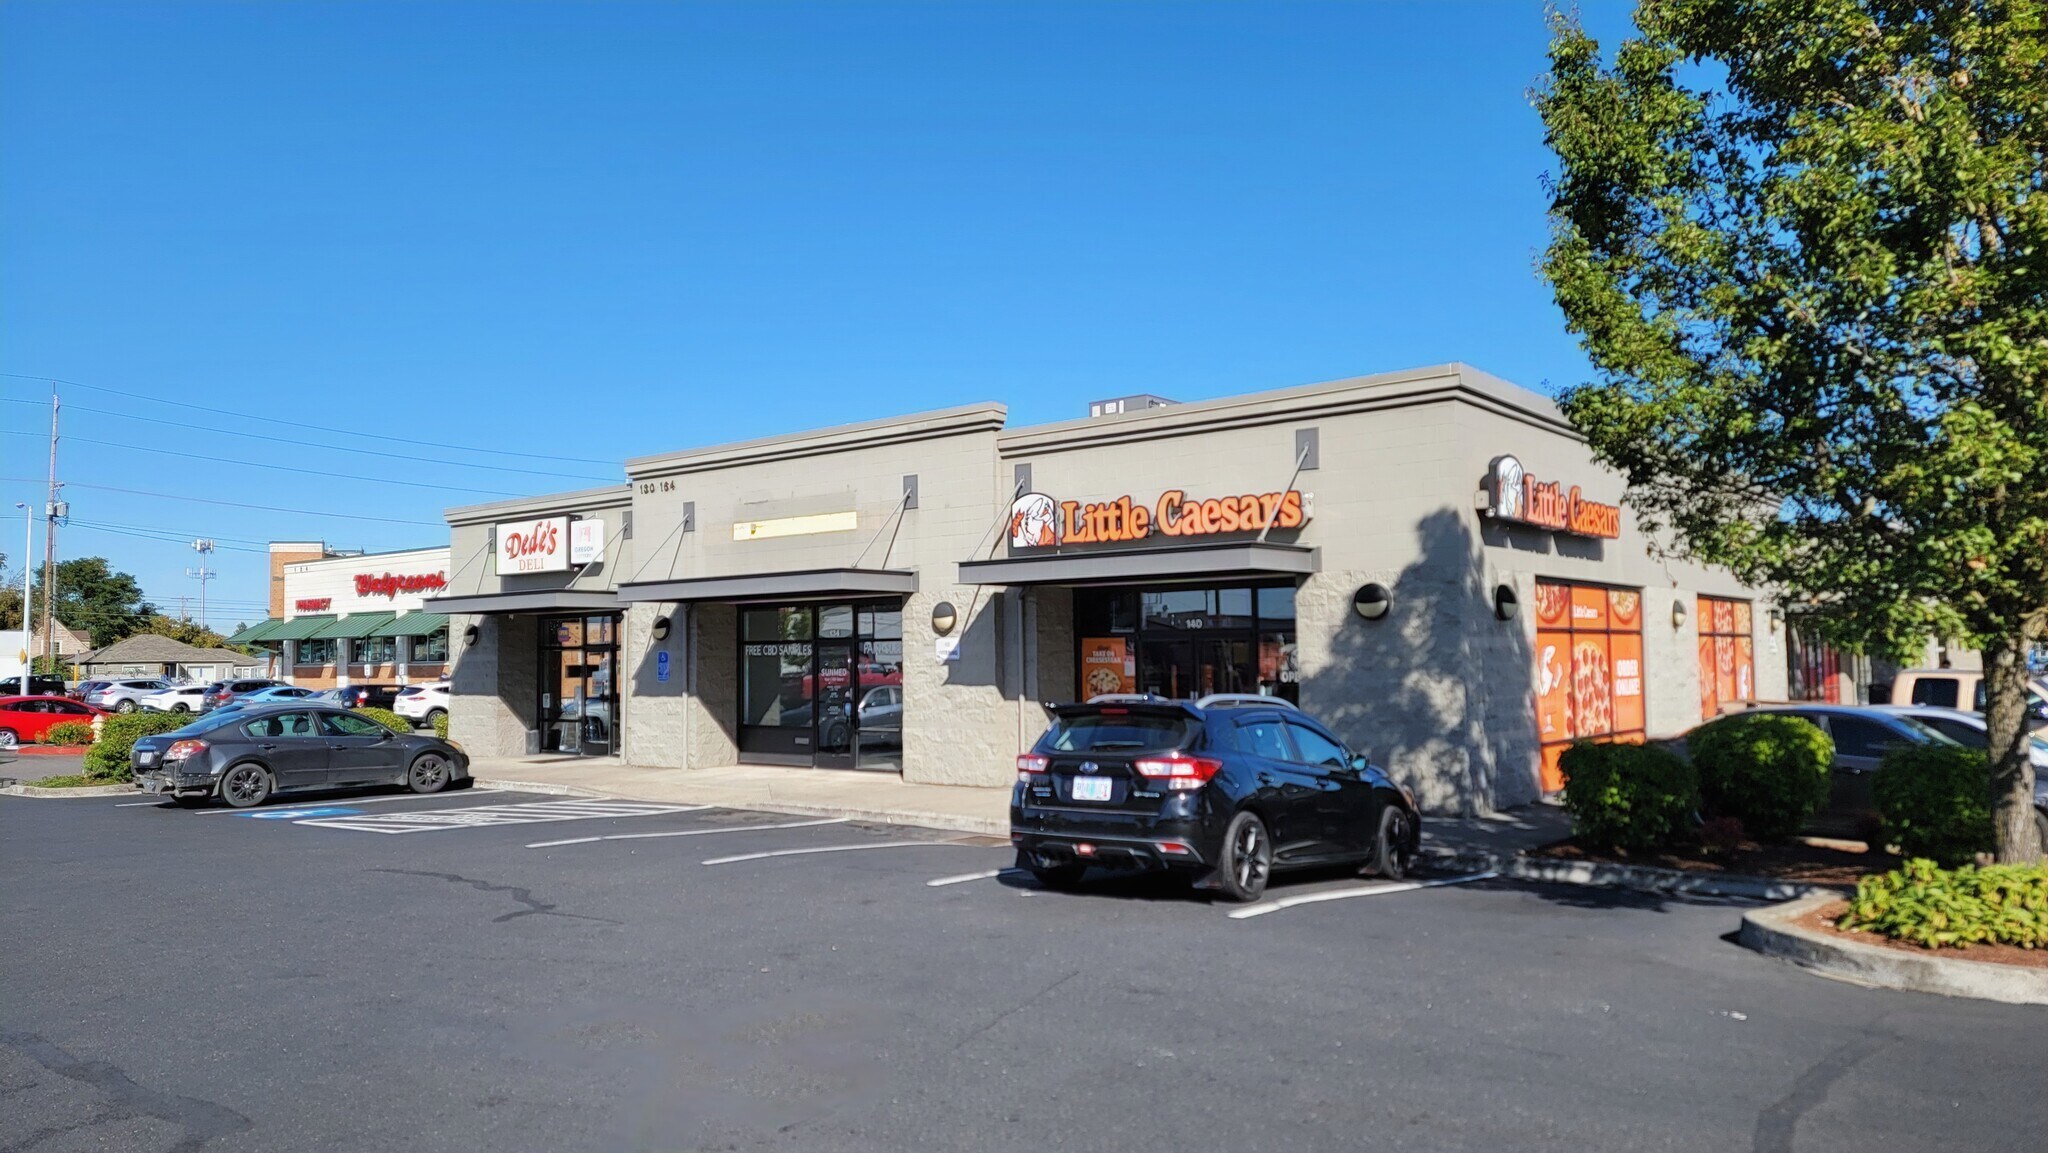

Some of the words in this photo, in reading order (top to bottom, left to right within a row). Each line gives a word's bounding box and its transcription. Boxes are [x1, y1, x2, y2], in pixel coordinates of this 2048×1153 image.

[1524, 473, 1568, 529] Little
[1568, 485, 1620, 539] Caesars
[1061, 495, 1150, 544] Little
[1156, 490, 1304, 536] Caesars
[505, 520, 557, 559] Dede's
[519, 558, 544, 571] DELI
[354, 571, 448, 600] Walgreens
[1185, 618, 1203, 629] 140
[745, 645, 762, 656] FREE
[763, 645, 778, 656] CBD
[779, 643, 812, 656] SAMPLES
[821, 668, 847, 676] SUNMED
